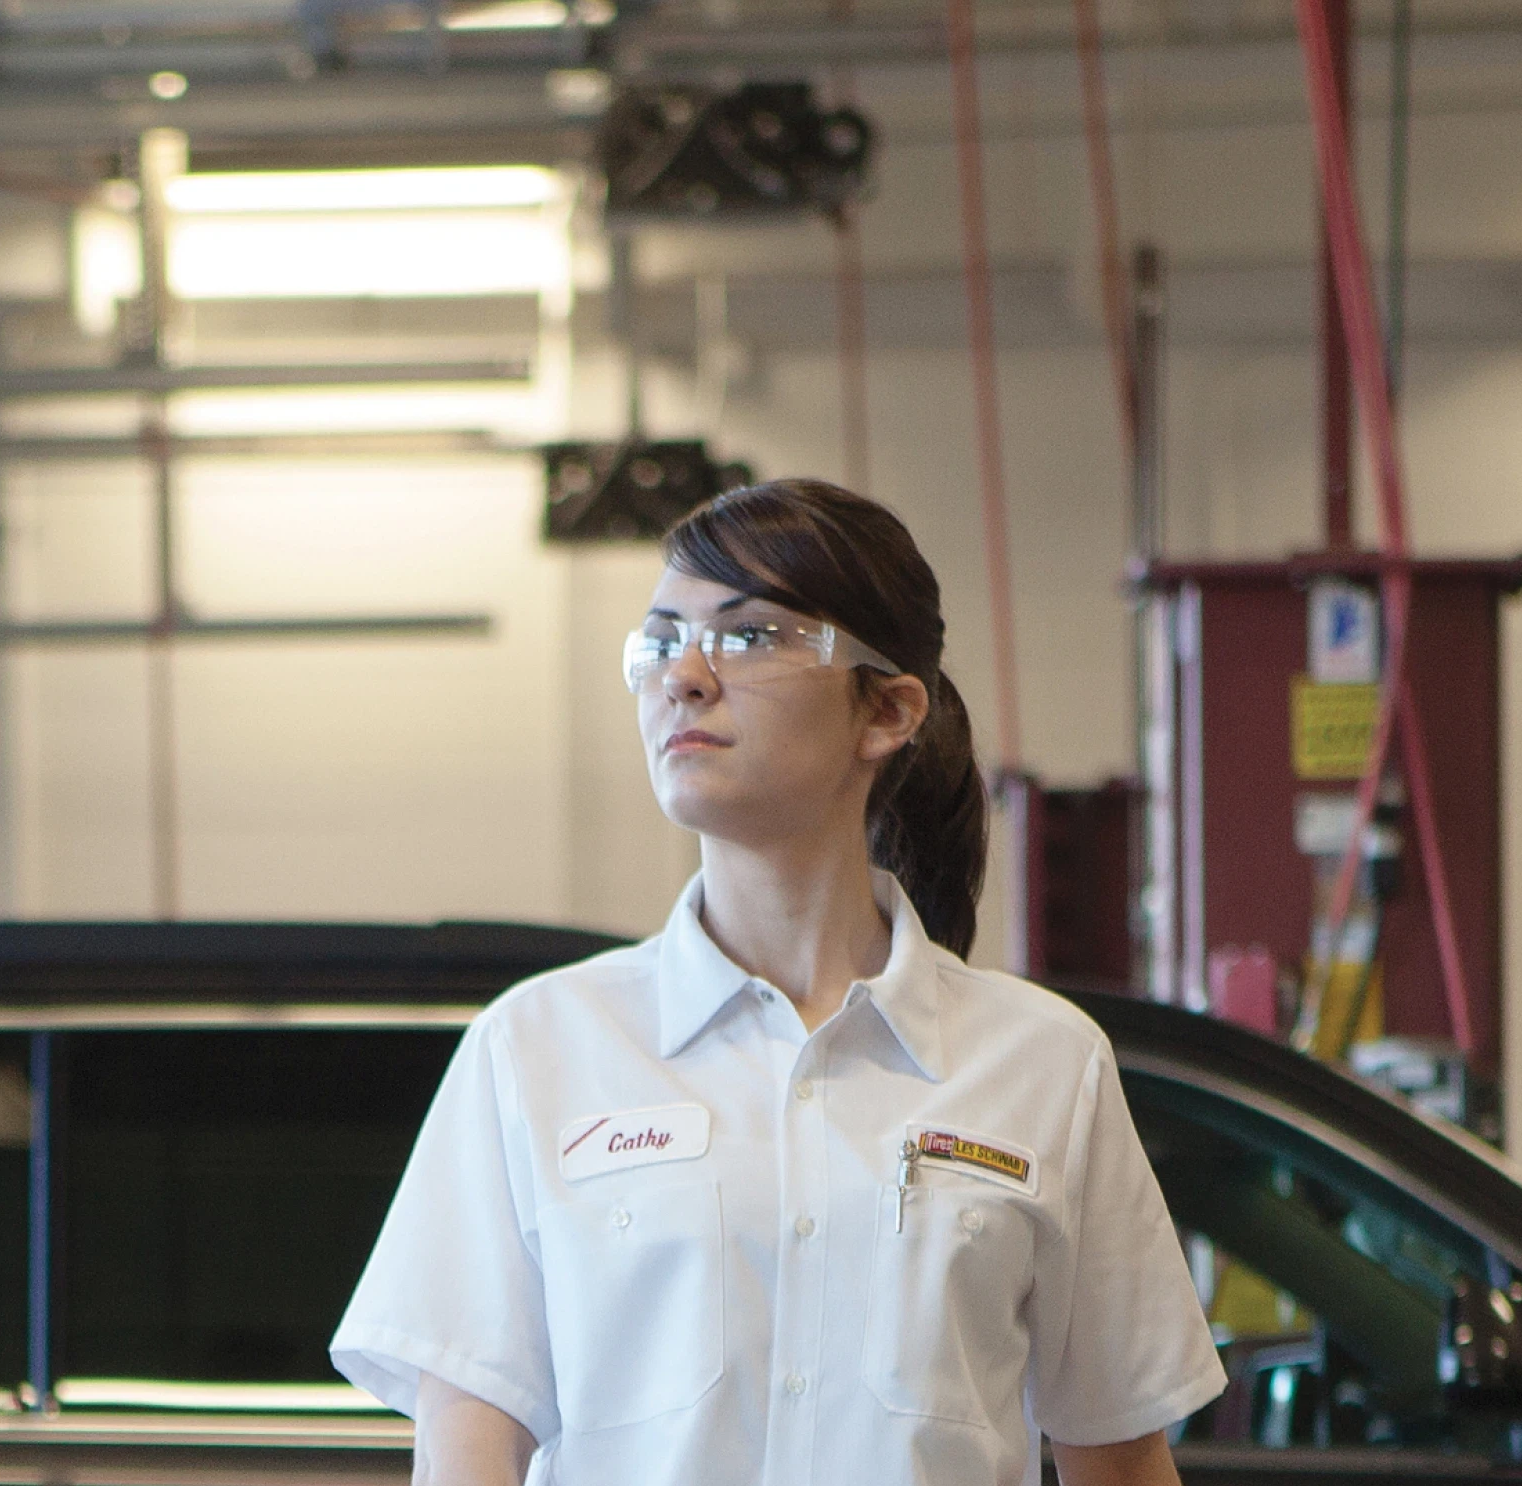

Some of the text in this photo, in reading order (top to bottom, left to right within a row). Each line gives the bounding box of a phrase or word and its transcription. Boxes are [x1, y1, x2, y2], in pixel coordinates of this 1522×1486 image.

[608, 1127, 674, 1153] Cathy
[956, 1140, 974, 1156] LES
[977, 1145, 1021, 1170] SCHWAB
